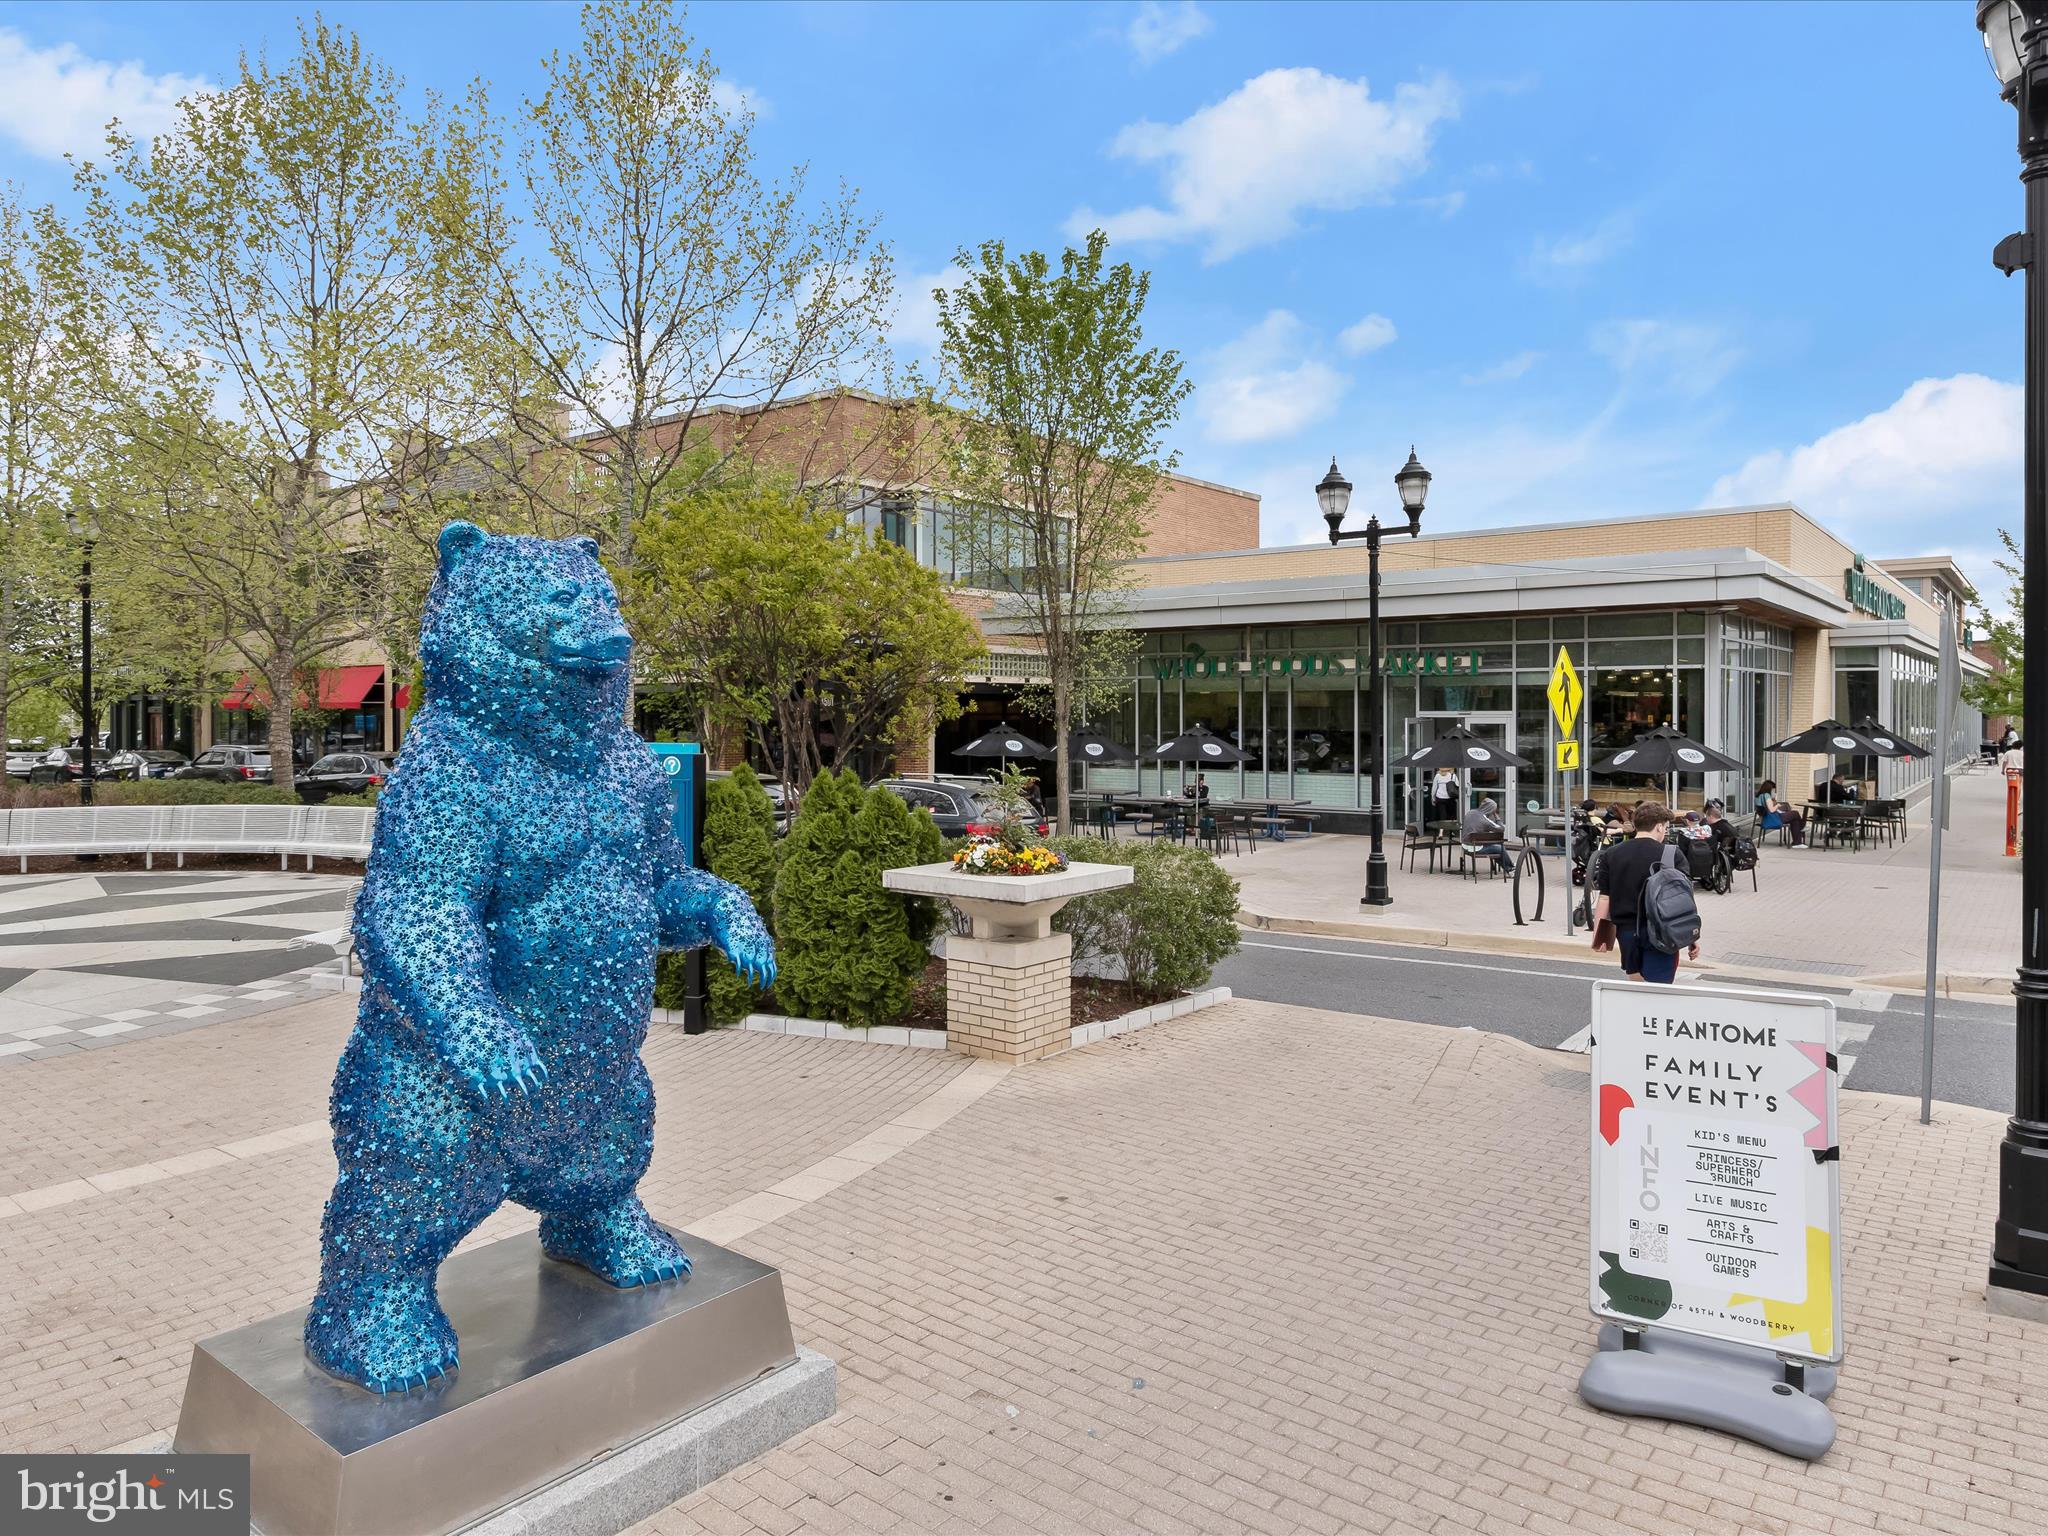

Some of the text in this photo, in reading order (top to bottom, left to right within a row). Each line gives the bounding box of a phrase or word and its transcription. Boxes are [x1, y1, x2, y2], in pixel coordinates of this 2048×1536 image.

[1151, 648, 1484, 680] WHOLE FOODS MARKET
[1643, 1017, 1777, 1047] LE FANTOME
[1645, 1055, 1763, 1082] FAMILY
[1645, 1082, 1778, 1113] EVENT'S
[1694, 1129, 1767, 1148] KID'S MENU
[1639, 1124, 1661, 1212] INFO
[1695, 1161, 1761, 1179] SUPERHERO
[1699, 1152, 1763, 1171] PRINCESS/
[1695, 1193, 1768, 1213] LIVE MUSIC
[1706, 1219, 1750, 1234] ARTS &
[1710, 1229, 1754, 1245] CRAFTS
[1705, 1252, 1757, 1269] OUTDOOR
[1712, 1264, 1750, 1278] GAMES
[1627, 1294, 1667, 1308] CORNER
[1671, 1303, 1684, 1311] OF
[1688, 1306, 1714, 1317] 45TH
[1730, 1313, 1795, 1332] WOODBERRY
